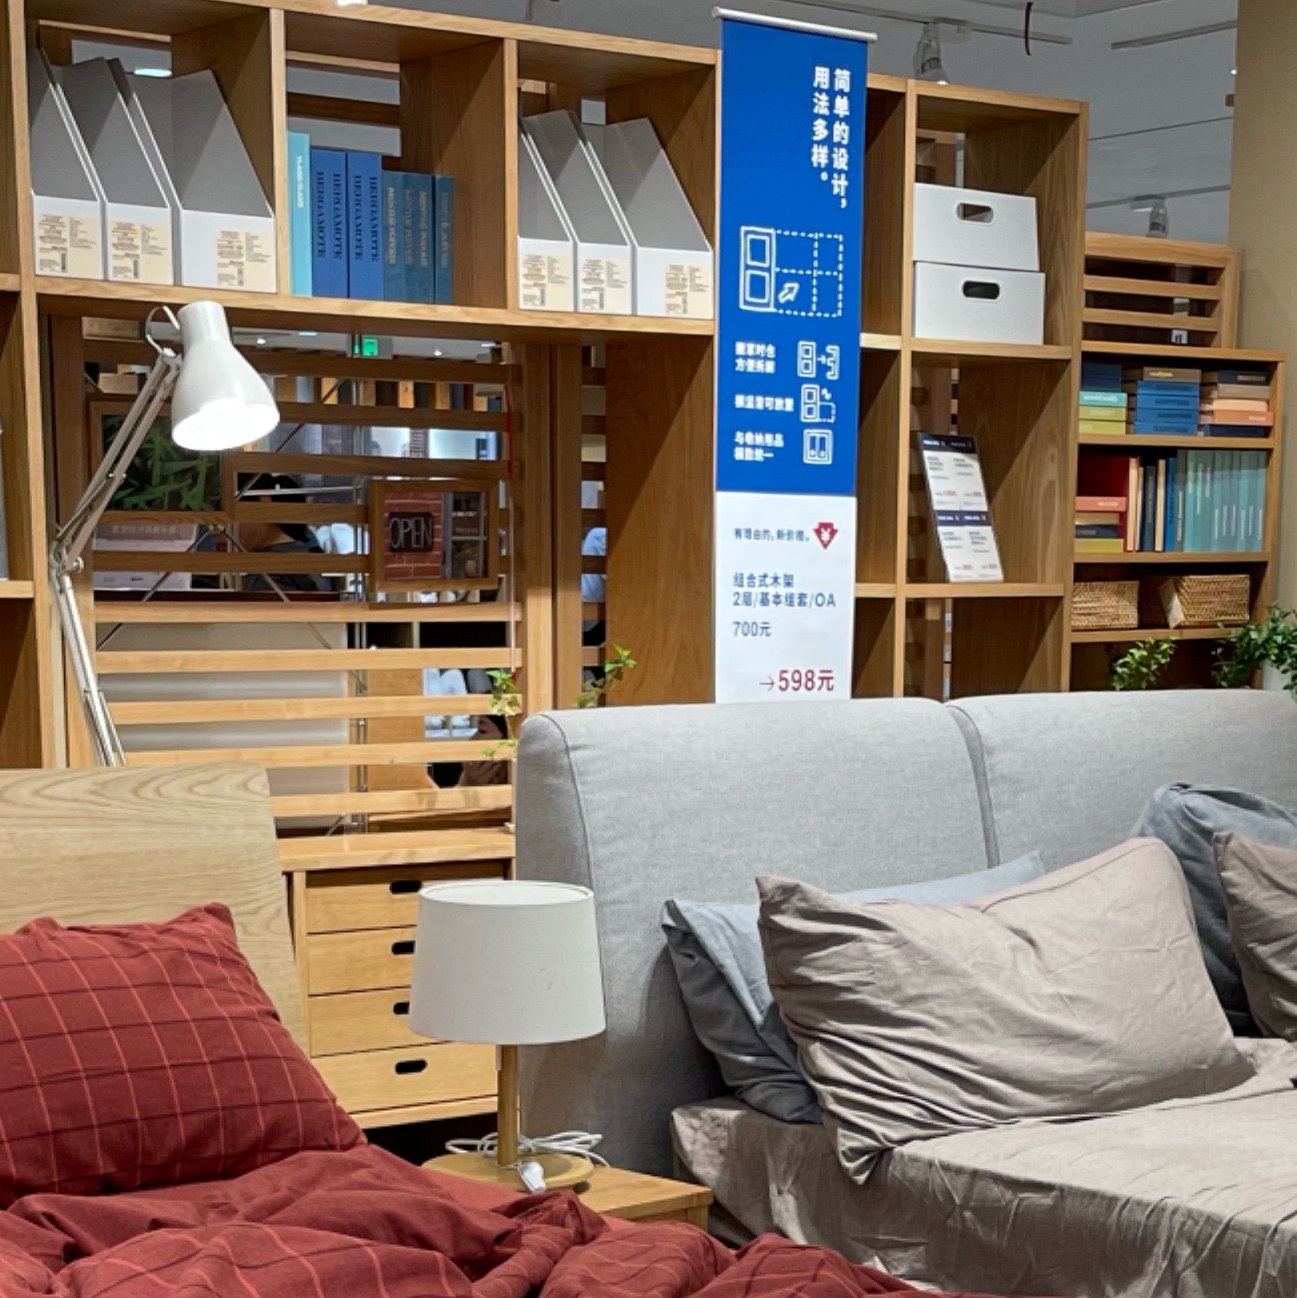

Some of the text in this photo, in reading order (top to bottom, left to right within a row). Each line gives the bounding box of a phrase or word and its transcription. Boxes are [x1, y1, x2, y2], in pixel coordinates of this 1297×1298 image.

[811, 66, 831, 182] 用法多样。
[390, 517, 432, 549] OPEN
[733, 621, 772, 637] 700元
[778, 669, 835, 692] 598元
